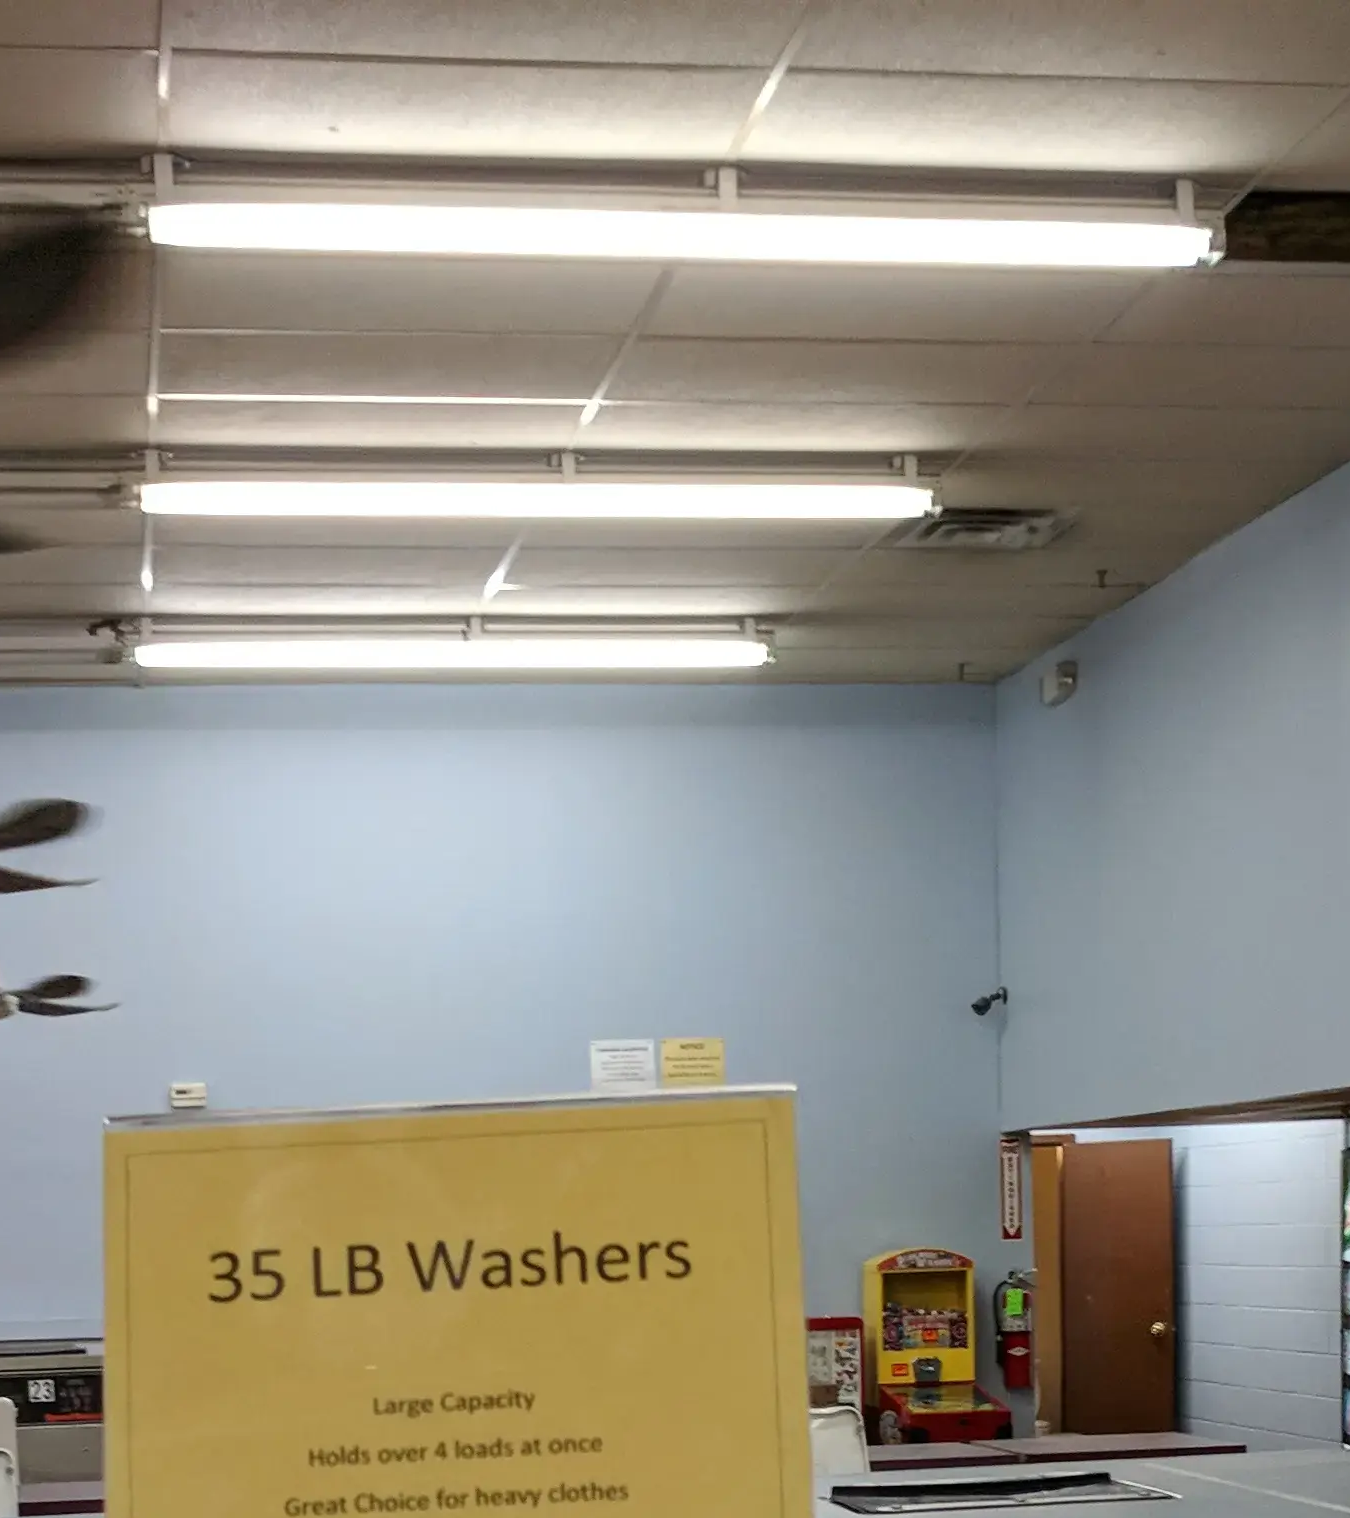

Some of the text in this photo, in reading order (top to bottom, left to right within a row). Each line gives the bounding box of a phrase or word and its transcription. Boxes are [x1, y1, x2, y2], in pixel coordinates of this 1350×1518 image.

[208, 1230, 692, 1304] 35 LB Washers
[30, 1379, 55, 1401] 23
[372, 1389, 536, 1419] Large Capacity
[307, 1436, 603, 1468] Holds over 4 loads at once
[283, 1481, 630, 1517] Great Choice for heavy clothes
